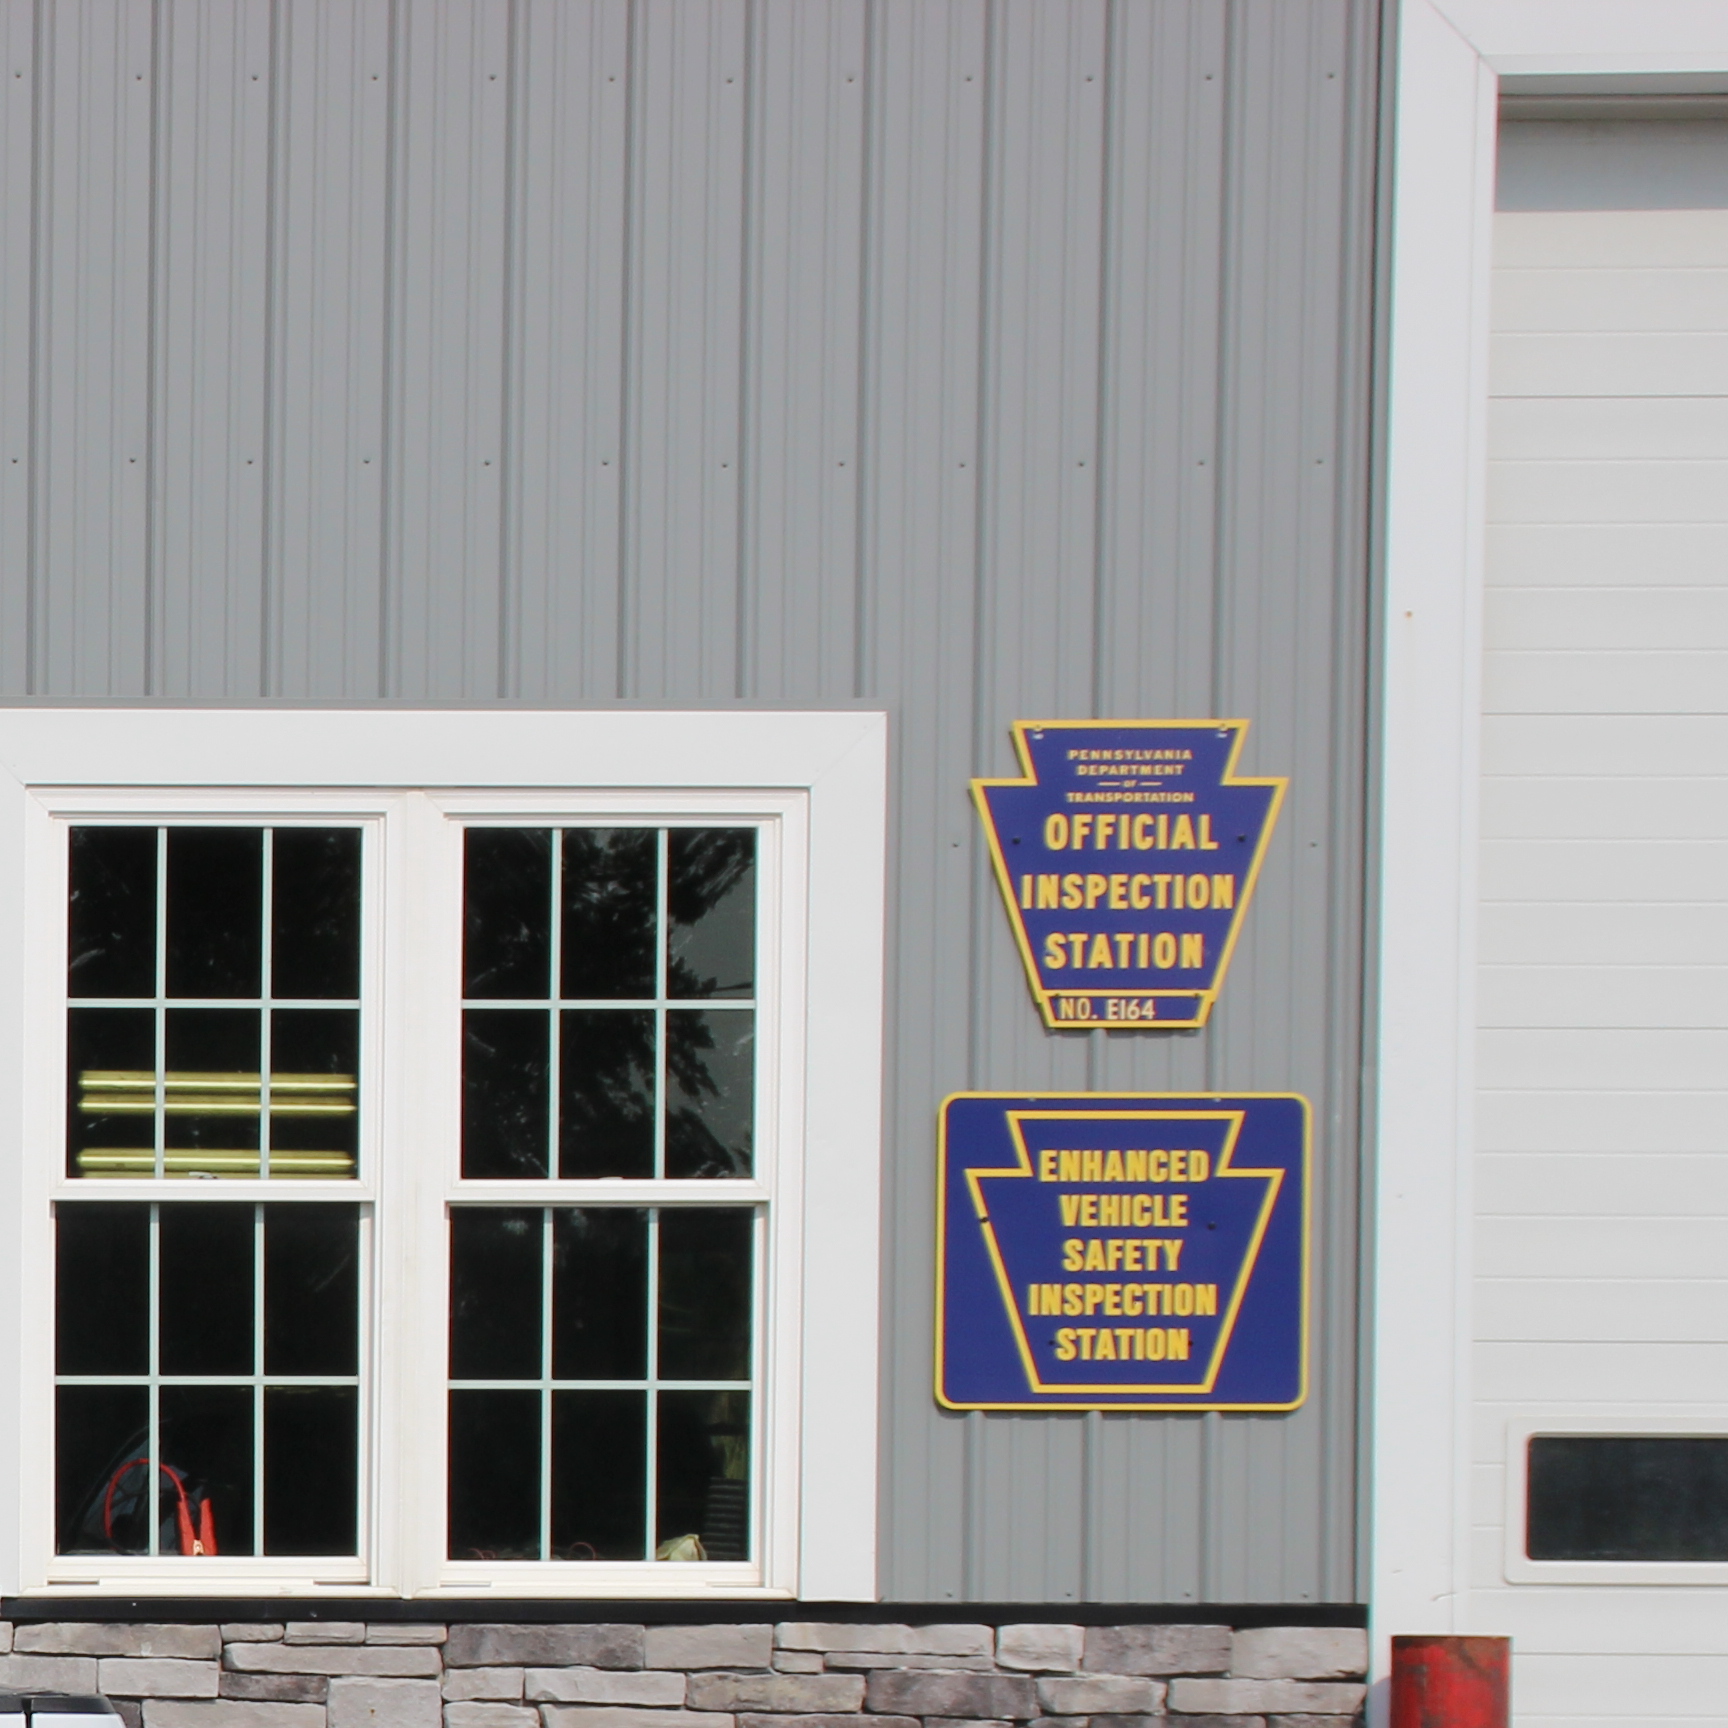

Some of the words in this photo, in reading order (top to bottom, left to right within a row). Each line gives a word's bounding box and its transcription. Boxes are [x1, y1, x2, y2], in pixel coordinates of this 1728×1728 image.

[1067, 749, 1193, 761] PENNSYLVANIA
[1076, 764, 1185, 776] DEPARTMENT
[1066, 792, 1195, 803] TRANSPORTATION
[1045, 813, 1219, 850] OFFICIAL
[1021, 874, 1234, 909] INSPECTION
[1044, 932, 1204, 969] STATION
[1059, 997, 1099, 1020] NO.
[1106, 999, 1156, 1020] E164
[1039, 1149, 1210, 1182] ENHANCED
[1059, 1194, 1189, 1226] VEHICLE
[1062, 1239, 1184, 1271] SAFETY
[1028, 1283, 1217, 1316] INSPECTION
[1055, 1328, 1189, 1361] STATION
